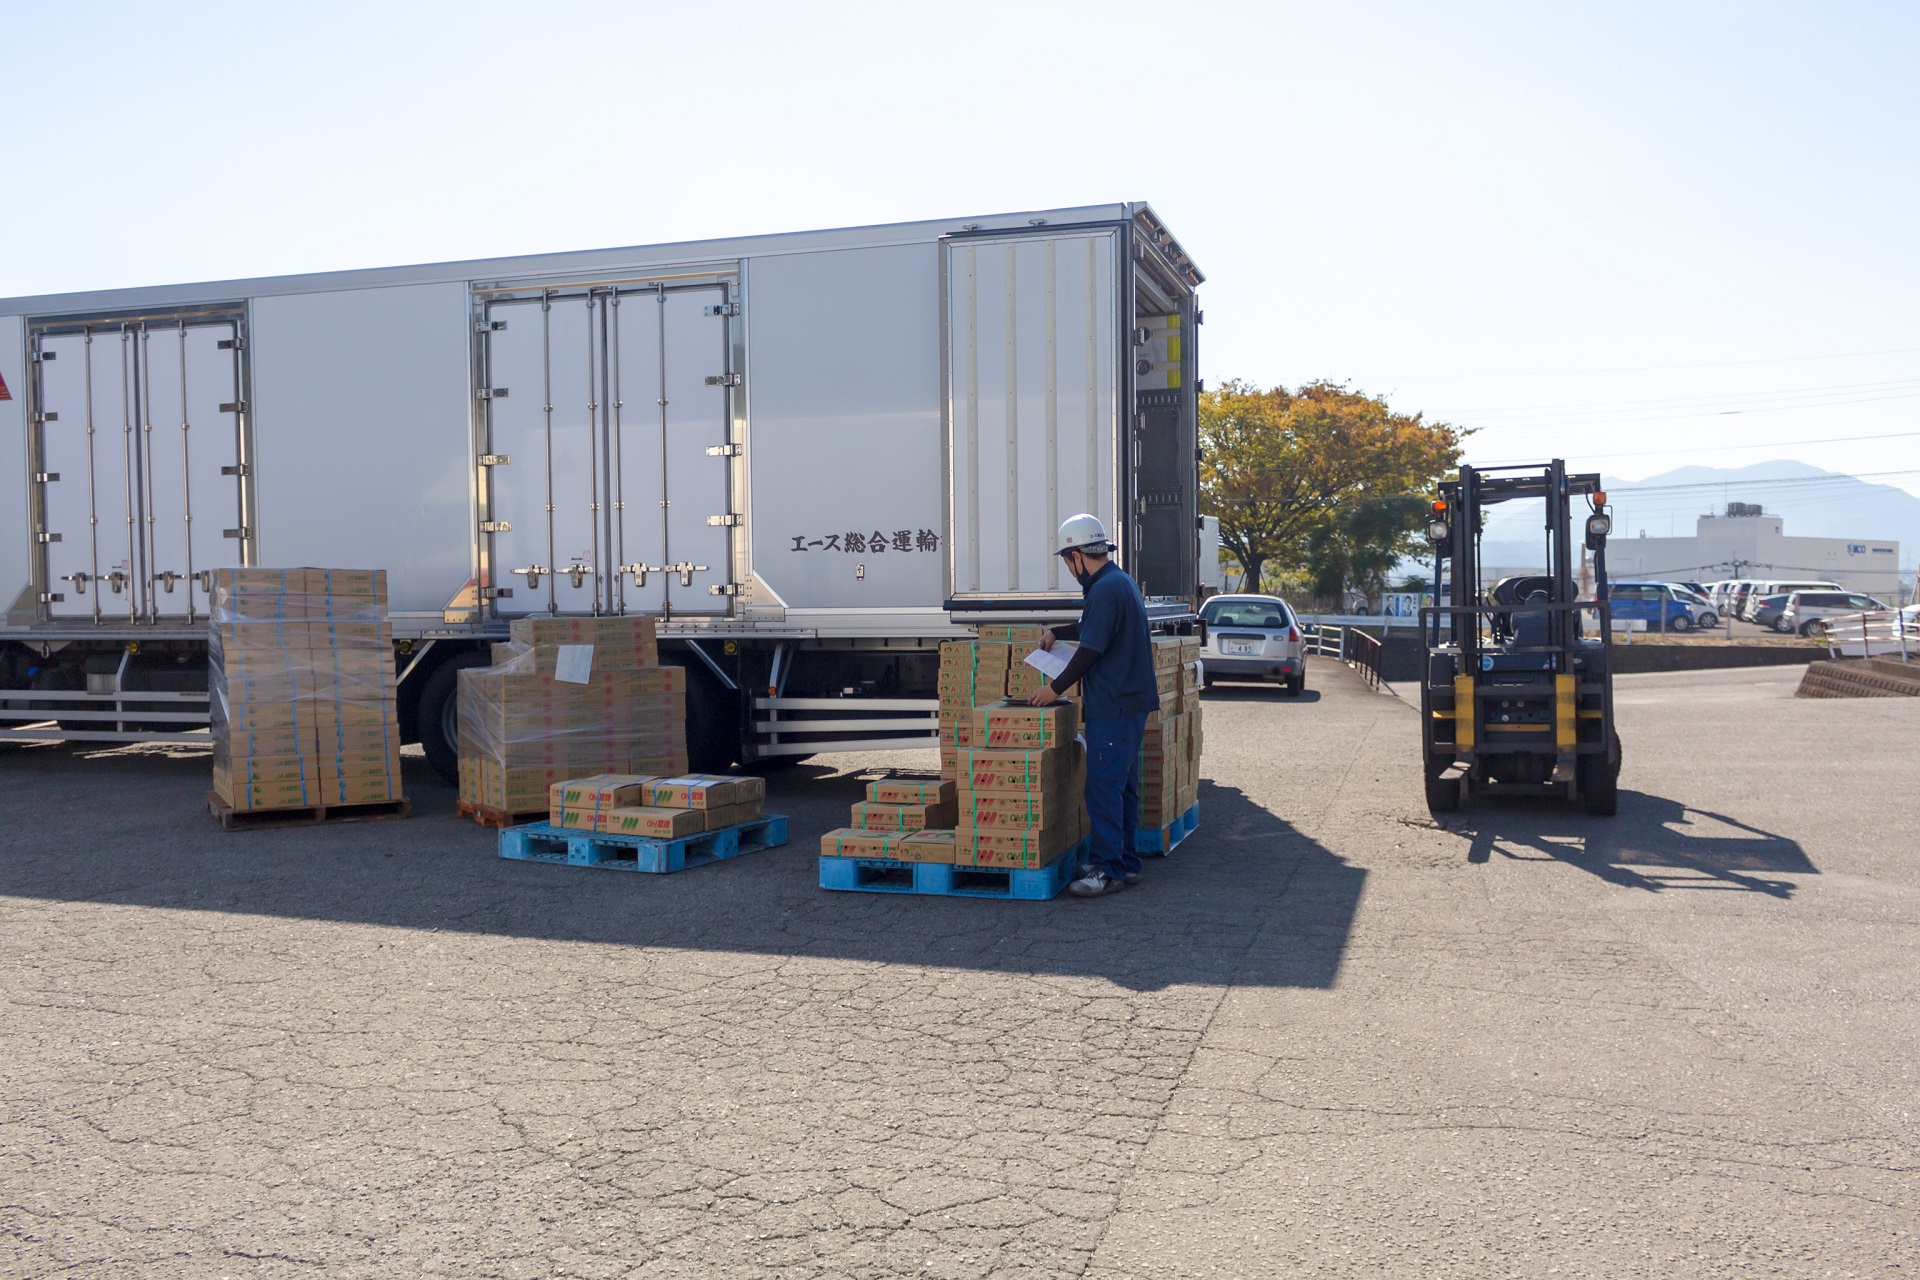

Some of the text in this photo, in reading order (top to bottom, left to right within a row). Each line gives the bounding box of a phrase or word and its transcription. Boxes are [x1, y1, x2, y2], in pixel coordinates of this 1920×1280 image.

[791, 529, 942, 553] エース総合運輸
[589, 793, 612, 802] Oh宮崎
[681, 791, 704, 800] Oh宮崎
